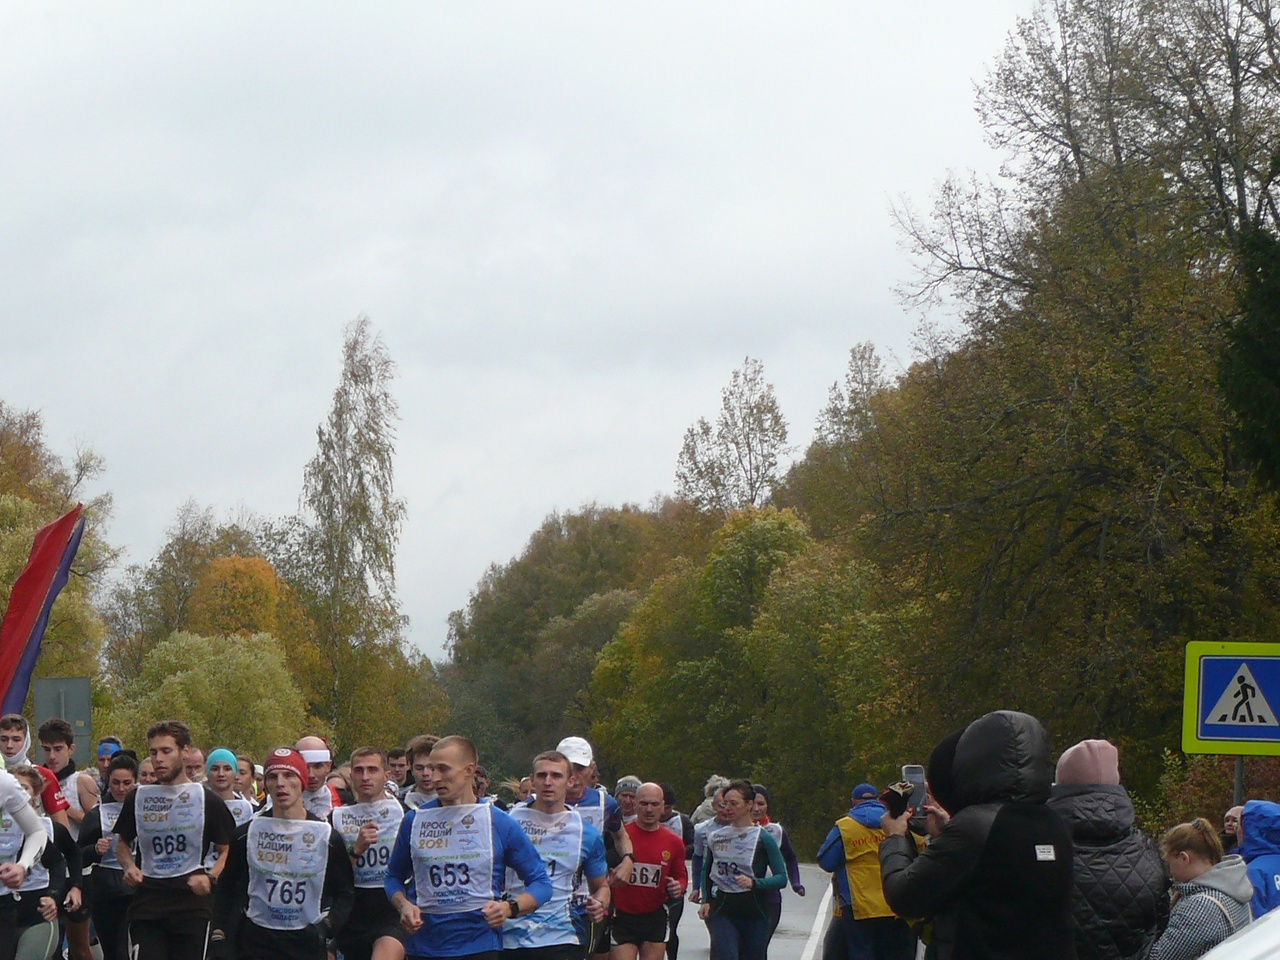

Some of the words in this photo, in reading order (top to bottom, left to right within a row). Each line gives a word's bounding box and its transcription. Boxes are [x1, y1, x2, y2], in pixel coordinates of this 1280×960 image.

[143, 804, 172, 812] НАЦИИ
[143, 813, 169, 823] 2021
[421, 821, 447, 829] КРОСС
[258, 832, 285, 842] КРОСС
[419, 828, 452, 838] НАЦИИ
[152, 834, 187, 855] 668
[257, 841, 293, 852] НАЦИИ
[418, 839, 449, 849] 2021
[257, 850, 289, 865] 2021
[429, 863, 470, 888] 653
[629, 866, 660, 886] 664
[265, 879, 306, 904] 765
